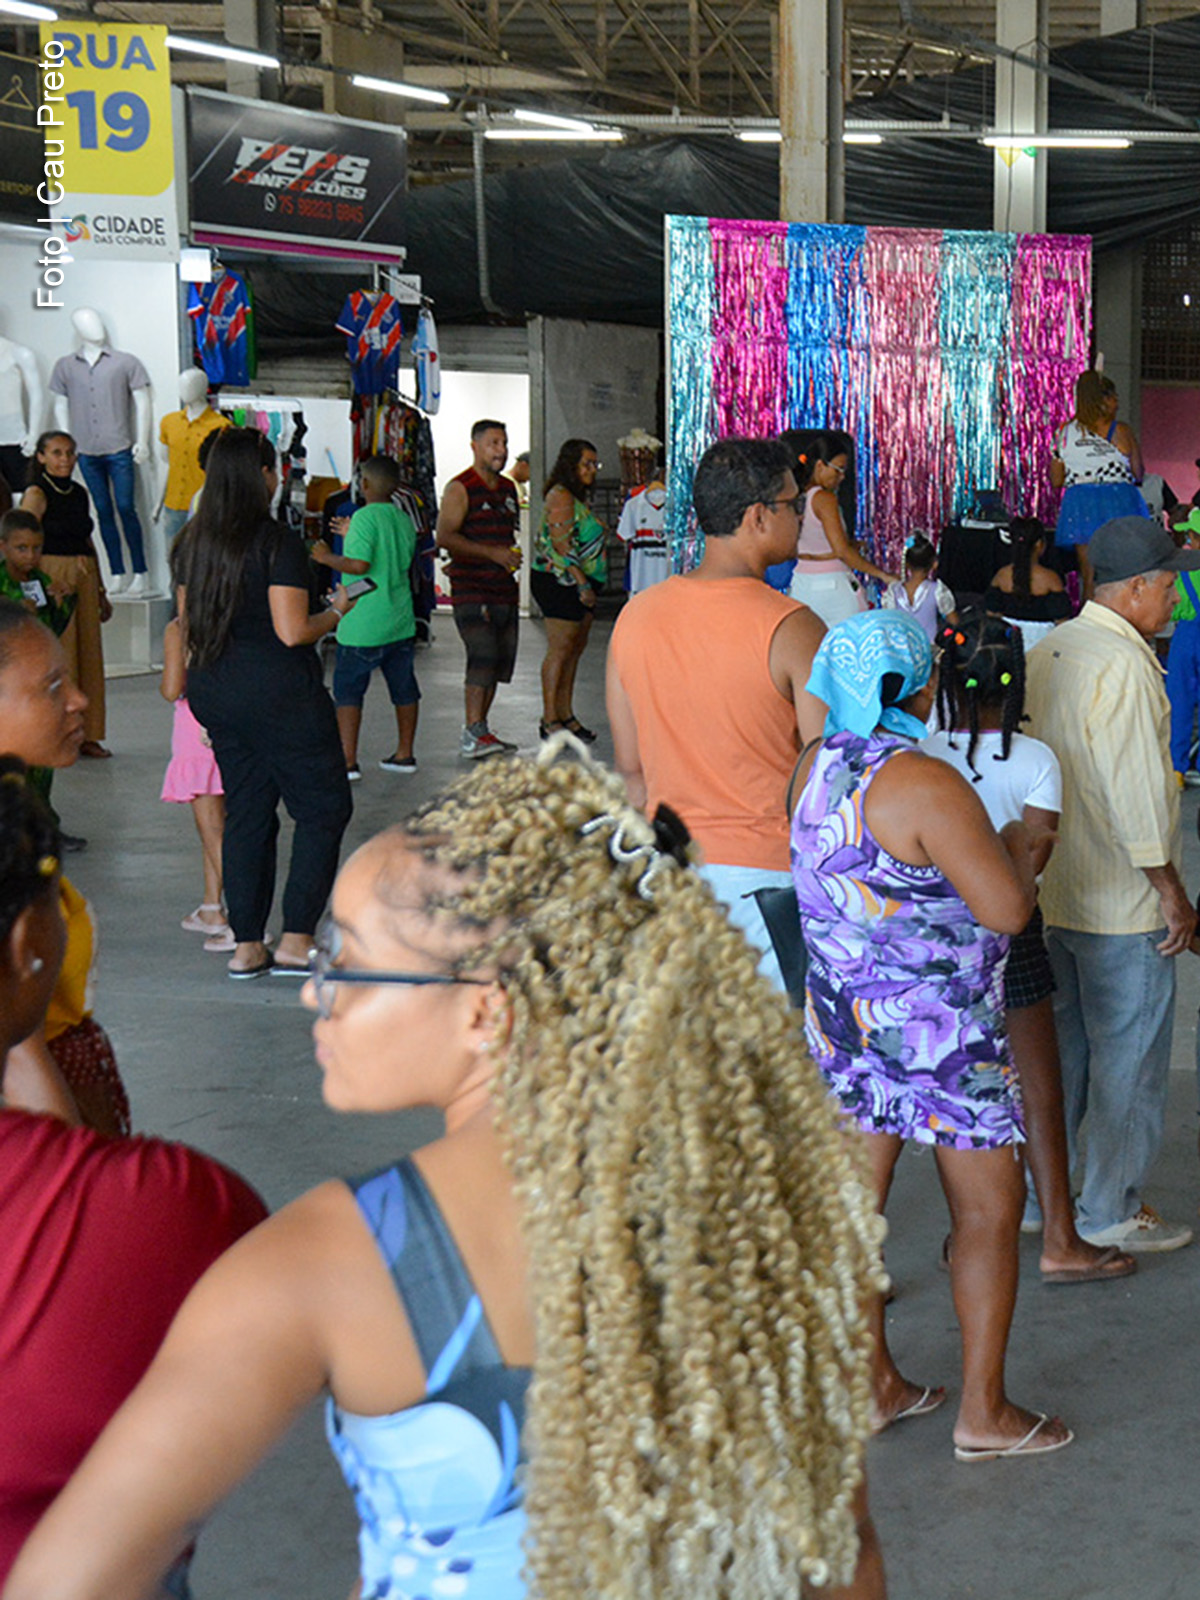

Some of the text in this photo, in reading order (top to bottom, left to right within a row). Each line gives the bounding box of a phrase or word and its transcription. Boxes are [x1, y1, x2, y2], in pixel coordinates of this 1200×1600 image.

[53, 32, 156, 71] RUA
[66, 91, 150, 152] 19
[92, 215, 165, 235] CIDADE
[94, 234, 166, 246] DAS COMPRAS
